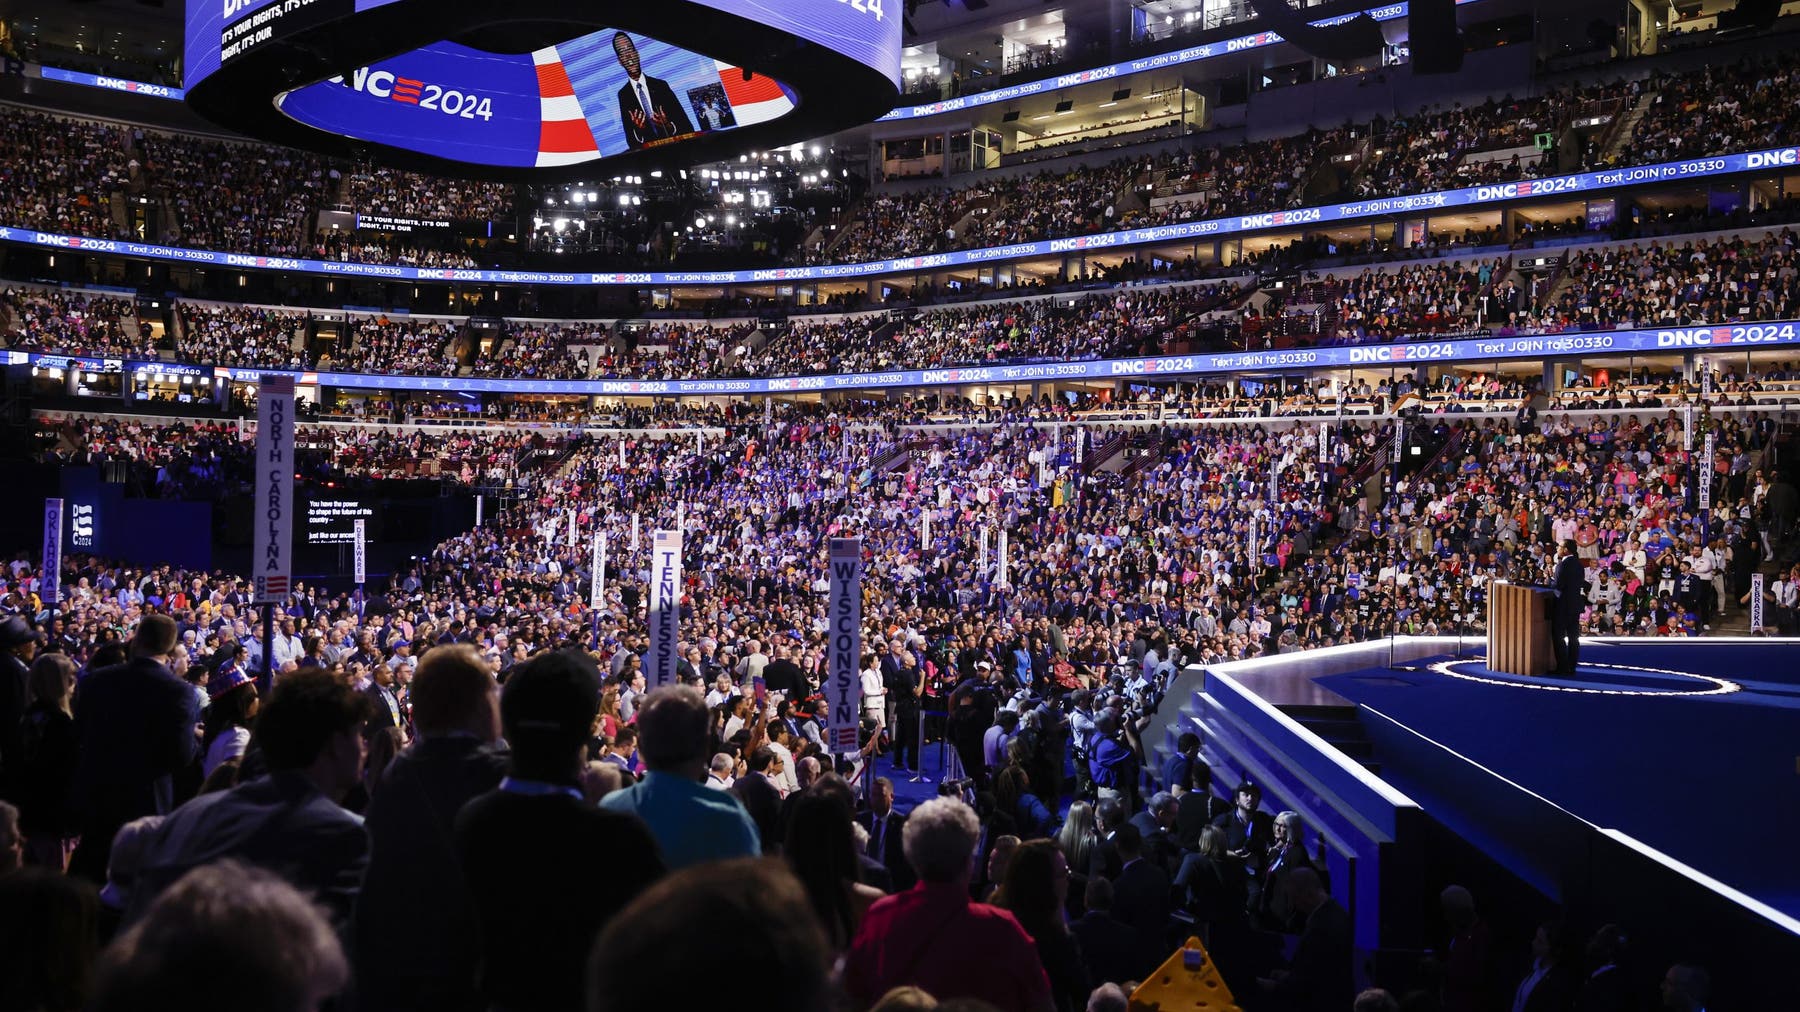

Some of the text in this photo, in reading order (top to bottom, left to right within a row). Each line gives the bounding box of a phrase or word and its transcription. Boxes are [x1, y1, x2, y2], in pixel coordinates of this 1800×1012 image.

[1371, 6, 1402, 18] 30330
[222, 29, 233, 44] IT'S
[234, 18, 252, 37] YOUR
[253, 5, 283, 28] RIGHTS,
[221, 26, 273, 62] RIGHT, IT'S OUR
[1227, 33, 1282, 51] DNC 20
[1132, 61, 1147, 69] Text
[1149, 56, 1168, 66] JOIN
[97, 77, 126, 90] DNC
[1058, 67, 1116, 87] DNC 2024
[328, 66, 493, 122] NC 2024
[1020, 83, 1041, 93] 30330
[913, 105, 936, 116] DNC
[942, 99, 964, 111] 2024
[1747, 149, 1796, 167] DNC
[1596, 160, 1725, 184] Text JOIN to 30330
[1478, 174, 1577, 200] DNC 2024
[1340, 205, 1361, 217] Text
[1364, 201, 1390, 212] JOIN
[360, 222, 382, 230] RIGHT,
[394, 218, 421, 226] RIGHTS,
[1241, 209, 1320, 229] DNC 2024
[1154, 228, 1176, 237] JOIN
[1189, 221, 1218, 233] 30330
[36, 233, 115, 251] DNC 2024
[1050, 234, 1115, 251] DNC 2024
[128, 245, 147, 253] Text
[185, 251, 214, 260] 30330
[967, 245, 1035, 261] Text JOIN 30330
[227, 255, 298, 268] DNC 2024
[864, 264, 884, 272] 30330
[893, 255, 946, 270] DNC 2024
[374, 267, 401, 275] 30330
[418, 269, 482, 279] DNC 2024
[592, 274, 651, 283] DNC 2024
[754, 268, 811, 280] DNC 2024
[1658, 326, 1795, 346] DNC 2024
[1476, 336, 1613, 353] Text JOIN to 30330
[1211, 357, 1234, 368] Text
[1236, 355, 1262, 366] JOIN
[1280, 352, 1316, 364] 30330
[1350, 344, 1454, 362] DNC 2024
[166, 367, 201, 376] CHICAGO
[1022, 368, 1044, 376] JOIN
[1057, 365, 1086, 374] 30330
[1112, 358, 1193, 373] DNC 2024
[768, 378, 822, 389] DNC 2024
[878, 375, 902, 383] 30330
[923, 369, 988, 382] DNC 2024
[603, 382, 666, 392] DNC 2024
[267, 400, 283, 571] NORTH CAROLINA
[1701, 462, 1709, 502] MAINE
[79, 537, 92, 546] 2024
[309, 532, 319, 540] just
[45, 510, 57, 588] OKLAHOMA
[355, 527, 363, 574] DELAWARE
[257, 576, 265, 600] DNC
[835, 562, 856, 724] WISCONSIN
